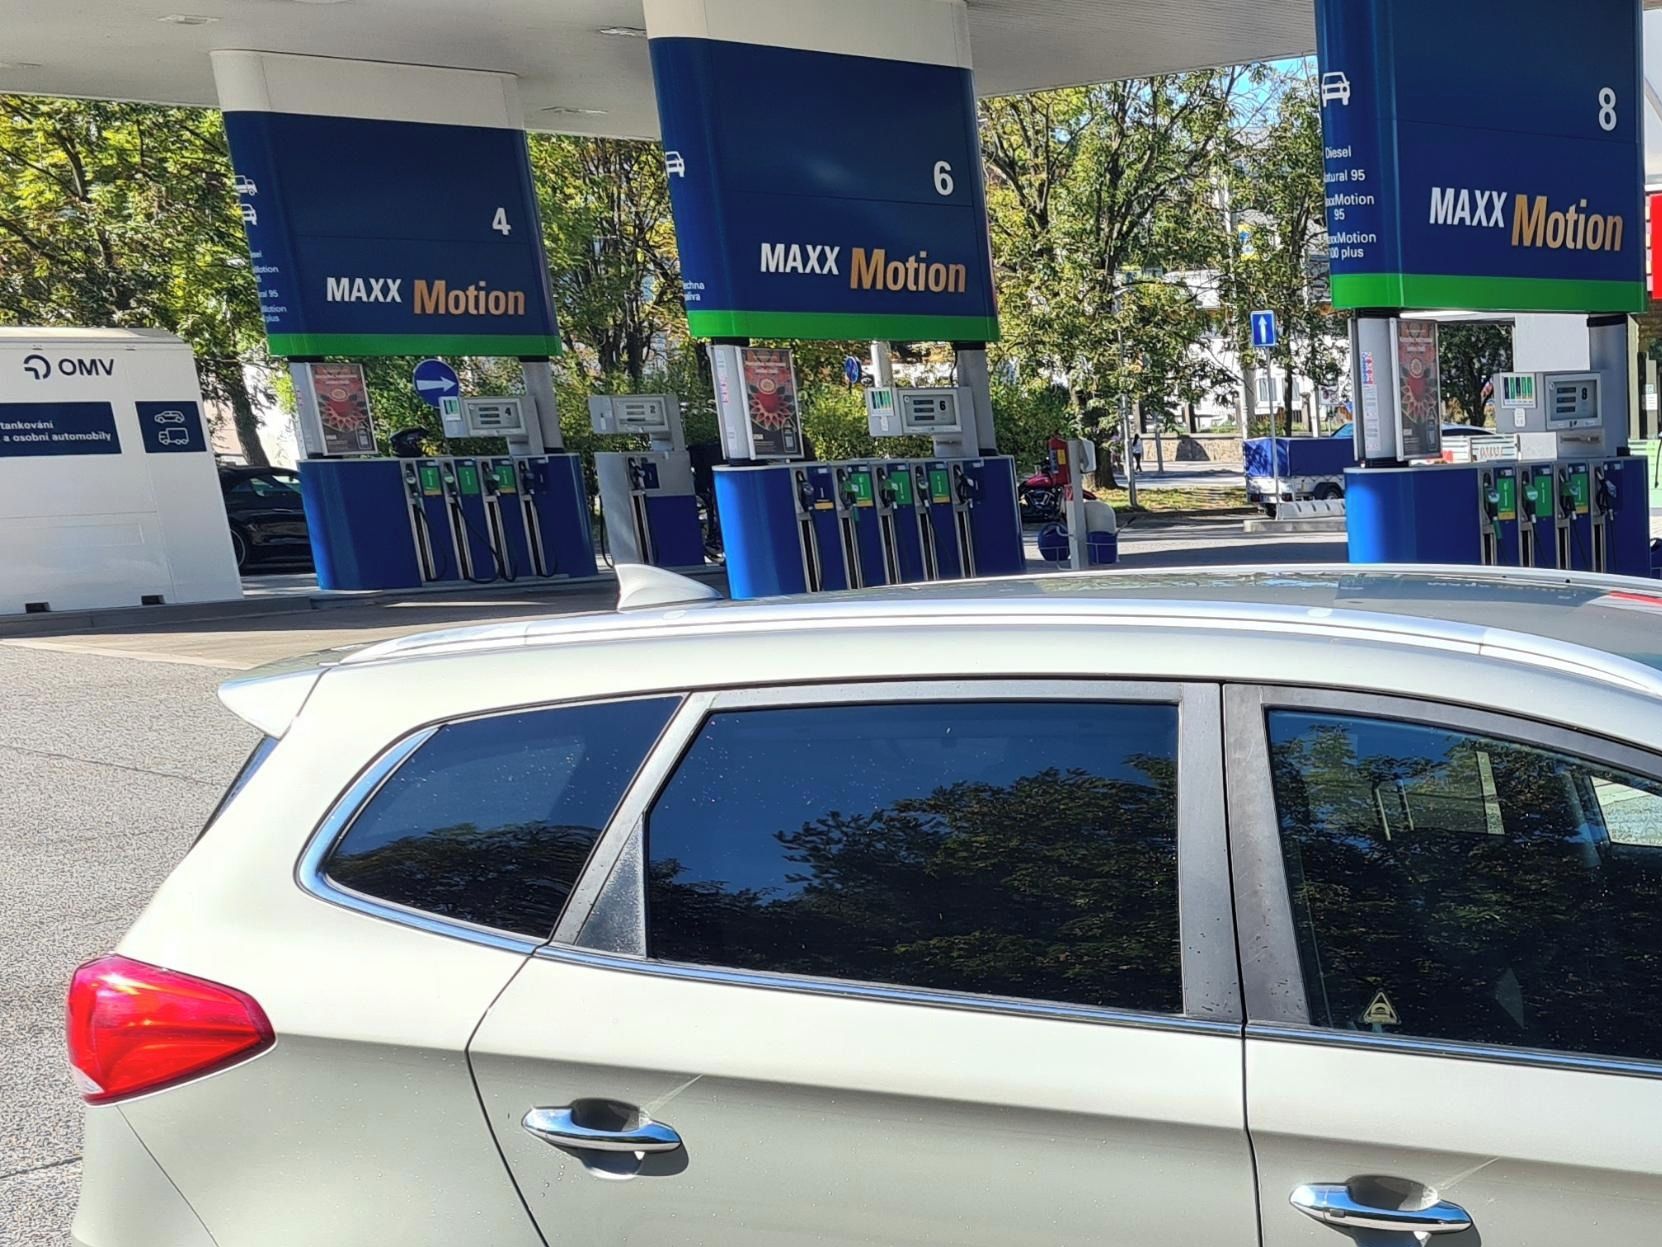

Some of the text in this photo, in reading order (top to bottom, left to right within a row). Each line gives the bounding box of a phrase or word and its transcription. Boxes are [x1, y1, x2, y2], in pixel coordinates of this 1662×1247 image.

[1598, 87, 1617, 131] 8
[1325, 146, 1352, 159] Diesel
[933, 160, 954, 196] 6
[1324, 169, 1366, 182] atural 95
[492, 207, 511, 235] 4
[1334, 208, 1345, 220] 95
[1429, 187, 1623, 251] MAXX Motion
[1341, 245, 1364, 261] plus
[760, 243, 966, 293] MAXX Motion
[326, 277, 525, 315] MAXX Motion
[58, 358, 114, 377] OMV
[505, 407, 512, 417] 4
[939, 400, 947, 411] 6
